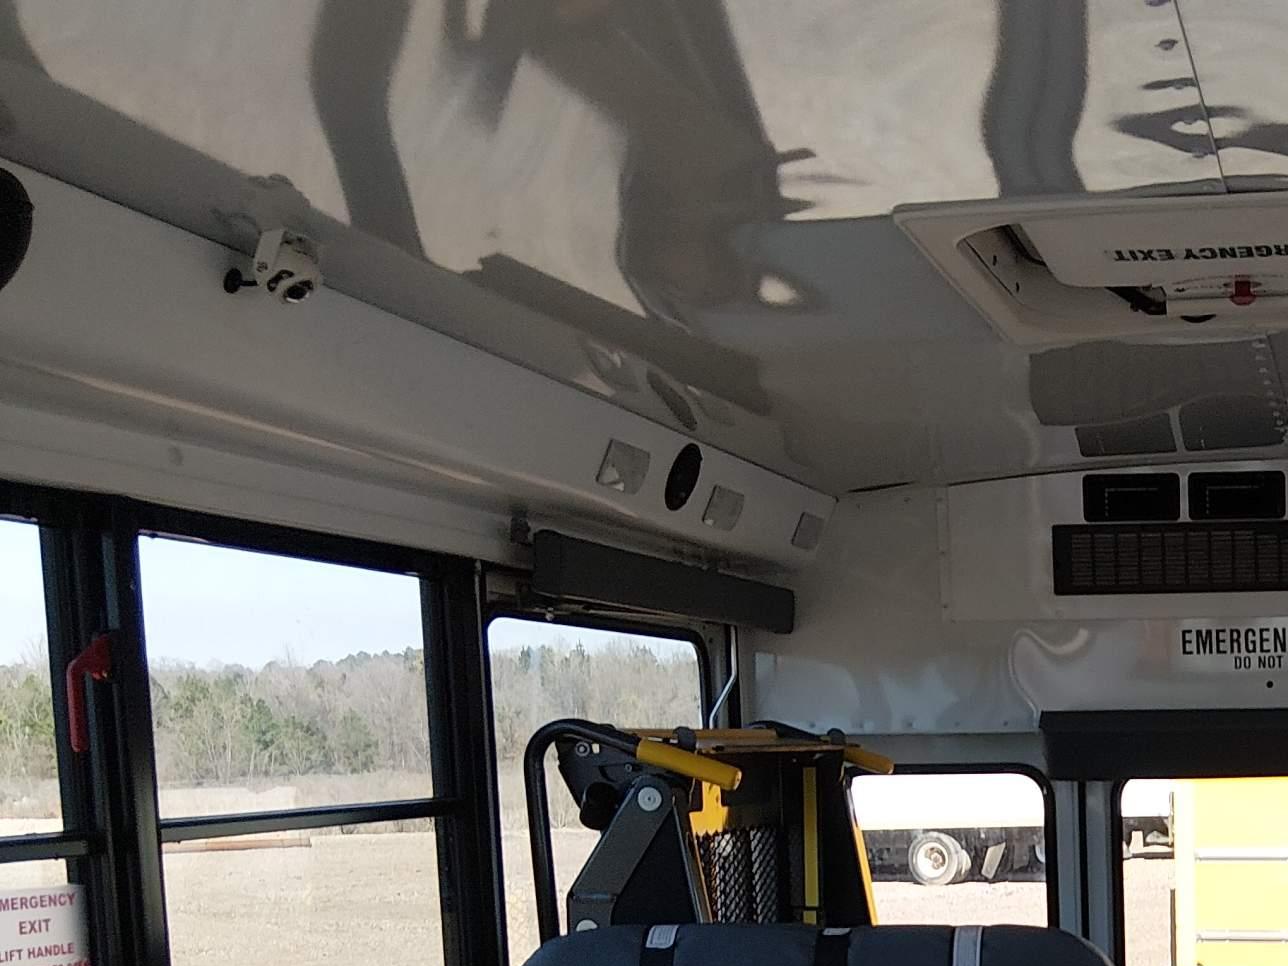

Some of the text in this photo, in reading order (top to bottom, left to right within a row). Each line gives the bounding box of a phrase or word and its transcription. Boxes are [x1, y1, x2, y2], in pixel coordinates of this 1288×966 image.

[1113, 249, 1175, 262] EXIT
[1234, 656, 1251, 669] DO
[1258, 655, 1284, 669] NOT
[18, 918, 51, 935] EXIT
[27, 942, 75, 959] HANDLE
